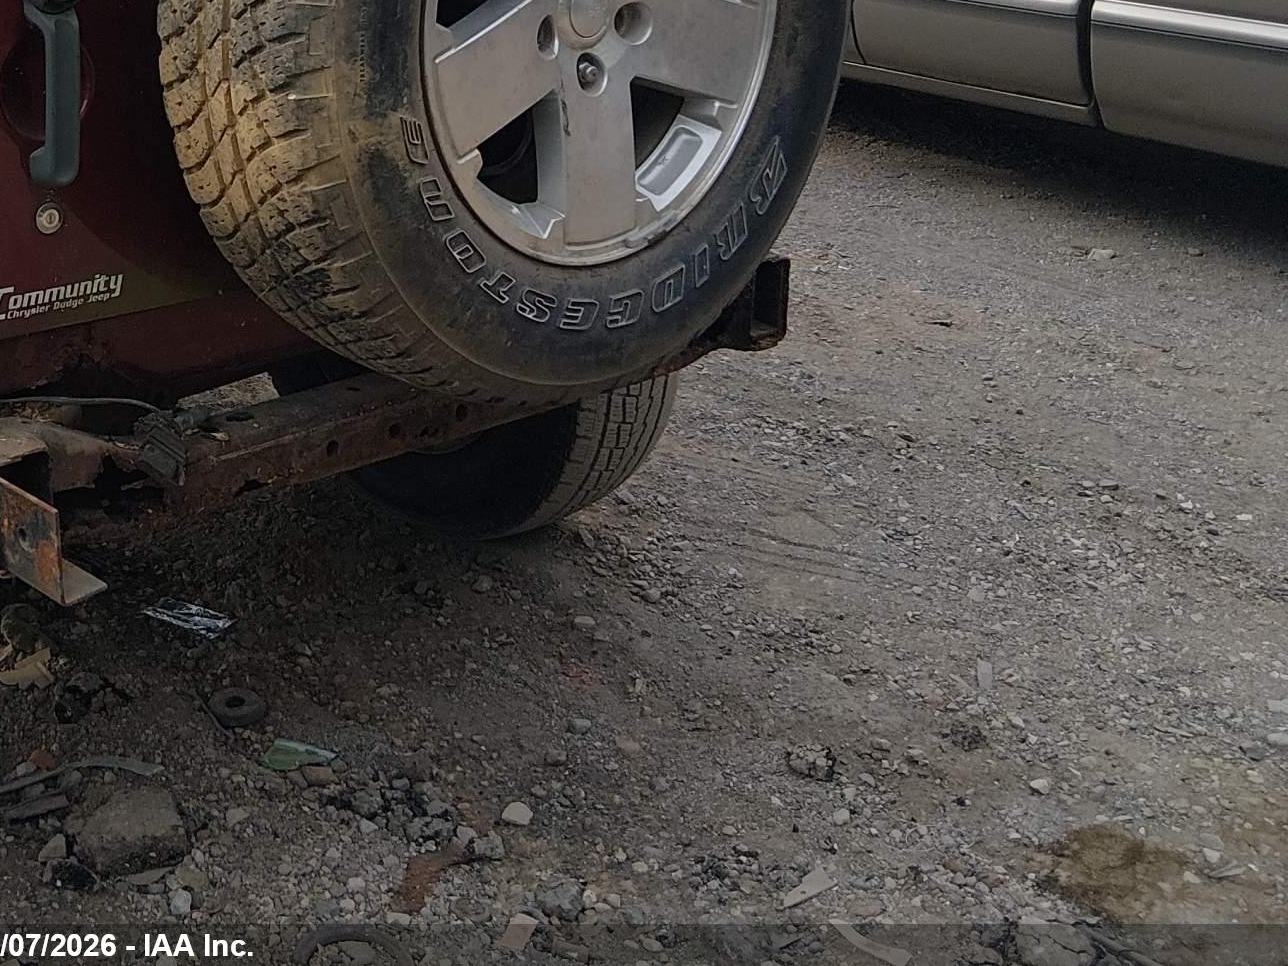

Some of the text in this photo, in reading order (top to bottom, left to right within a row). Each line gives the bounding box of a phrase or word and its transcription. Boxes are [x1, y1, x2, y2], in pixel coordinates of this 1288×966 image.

[399, 115, 789, 332] BRIDGESTONE
[7, 304, 50, 320] Chrysler
[87, 291, 111, 304] Jeep
